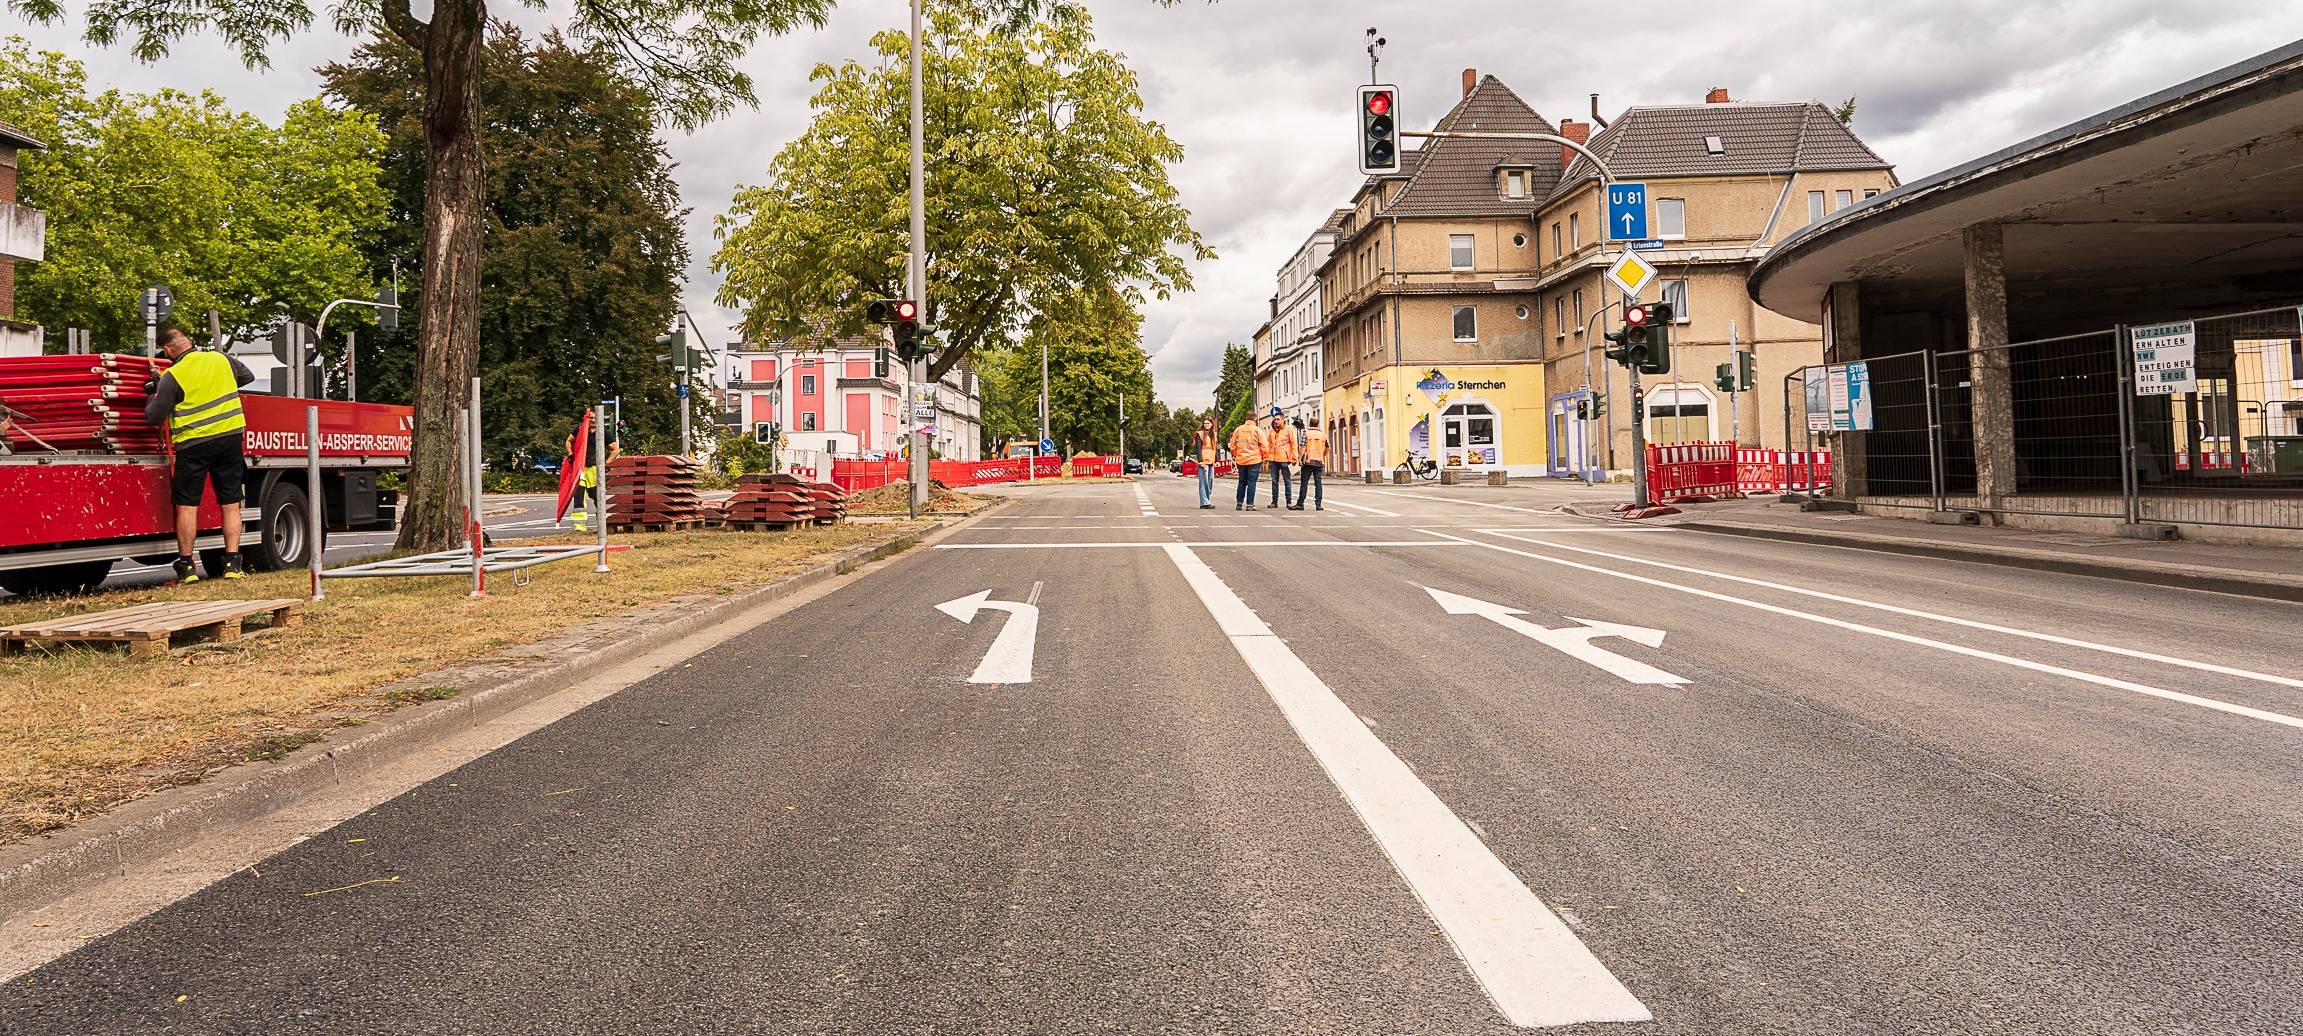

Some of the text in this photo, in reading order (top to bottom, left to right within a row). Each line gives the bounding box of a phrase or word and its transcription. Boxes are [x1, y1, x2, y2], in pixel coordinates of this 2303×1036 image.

[1612, 191, 1641, 204] U 81
[2137, 352, 2154, 360] RWE
[2139, 360, 2190, 370] ENTEIGNEN
[2161, 372, 2185, 380] ERDE
[1457, 380, 1506, 390] Sternchen
[246, 431, 412, 451] BAUSTELLN-ABSPERR-SERVICE
